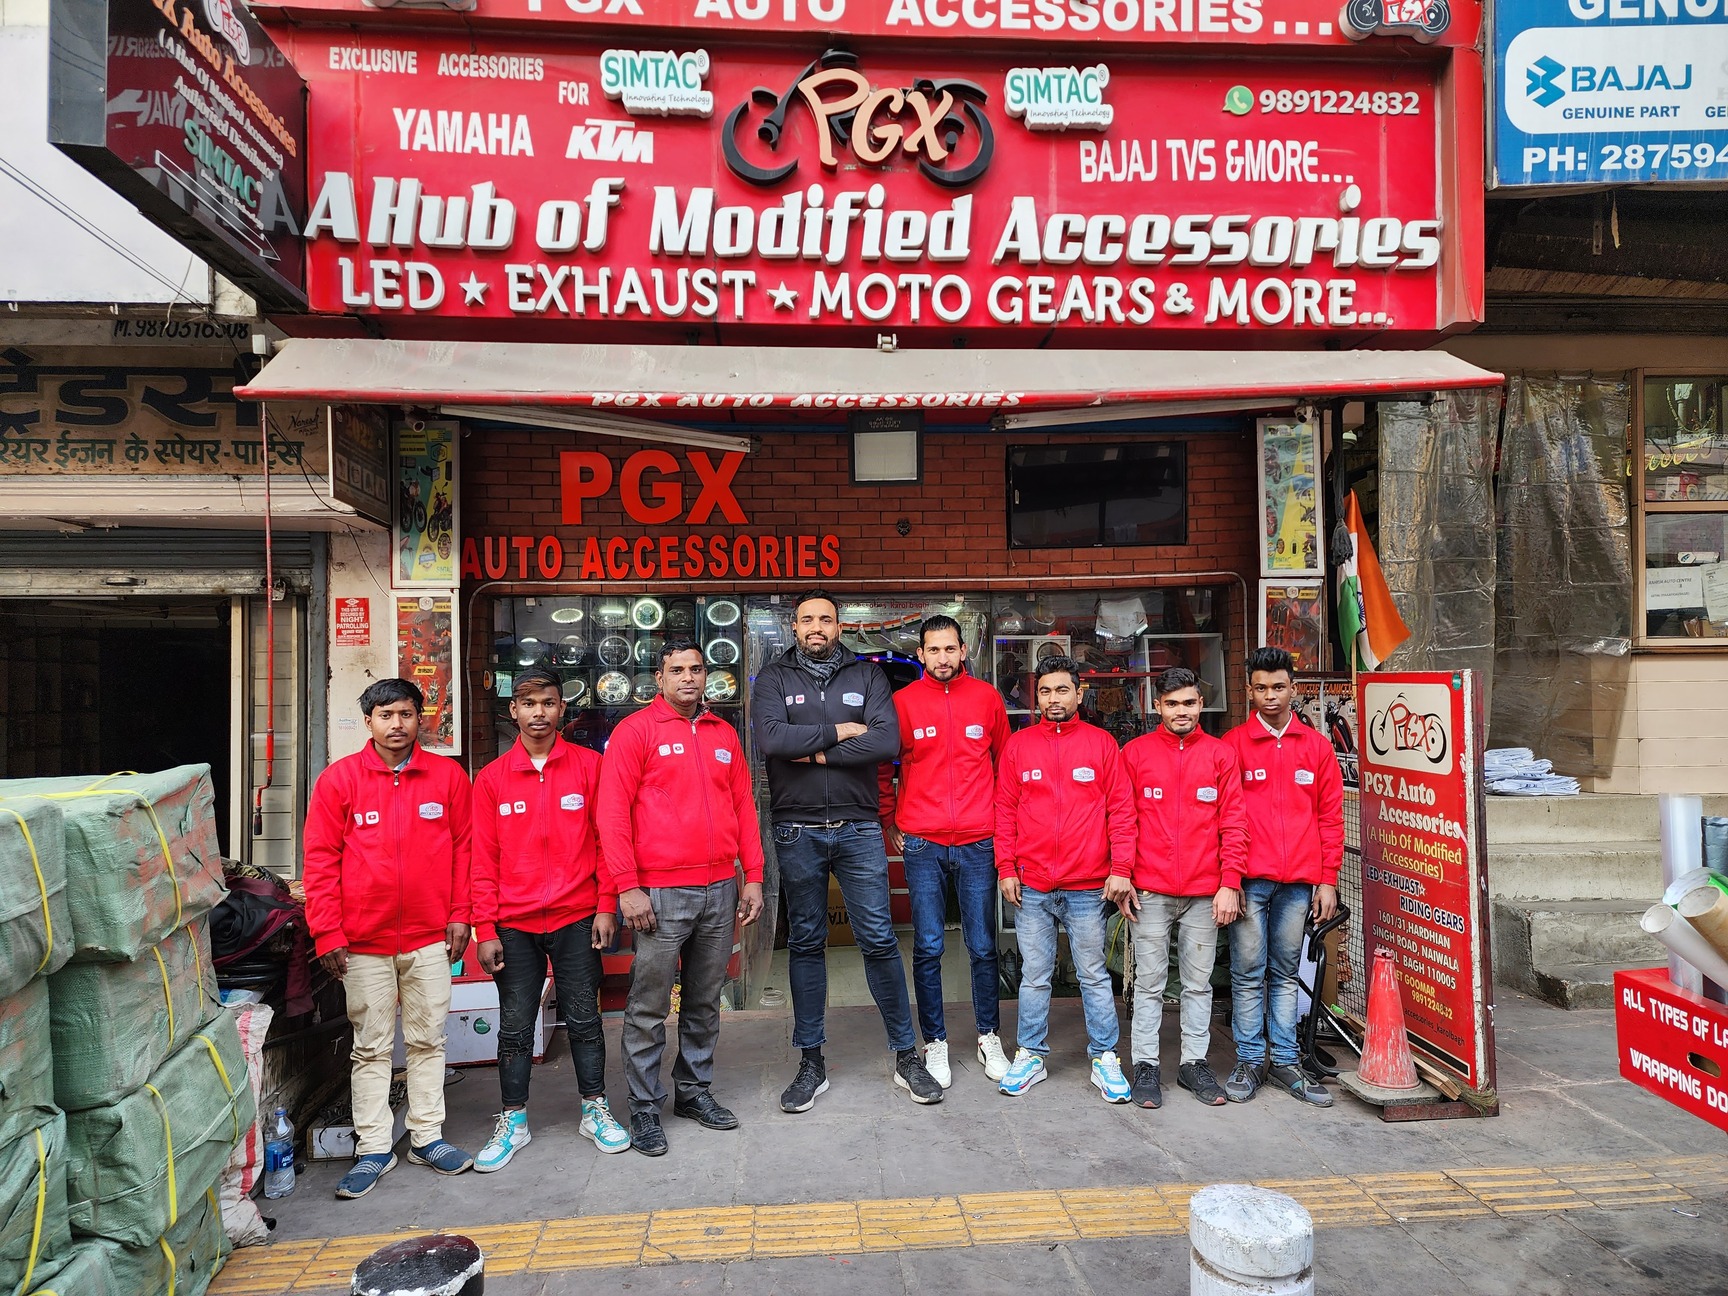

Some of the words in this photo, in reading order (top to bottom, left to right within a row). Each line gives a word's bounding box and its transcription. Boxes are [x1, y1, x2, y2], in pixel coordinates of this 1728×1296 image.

[179, 7, 222, 71] Auto
[223, 54, 297, 158] Accessories
[329, 46, 418, 75] EXCLUSIVE
[437, 52, 545, 82] ACCESSORIES
[558, 81, 589, 106] FOR
[1571, 63, 1692, 93] BAJAJ
[797, 67, 954, 173] PGX
[1259, 89, 1420, 116] 9891224832
[1562, 106, 1635, 120] GENUINE
[1640, 105, 1681, 118] PART
[1705, 106, 1728, 118] GE
[393, 108, 534, 158] YAMAHA
[565, 118, 654, 164] KTM
[1079, 139, 1158, 184] BAJAJ
[1166, 139, 1217, 183] TVS
[1523, 146, 1587, 173] PH:
[304, 171, 361, 243] A
[368, 176, 517, 252] Hub
[535, 177, 626, 253] of
[649, 183, 973, 267] Modified
[991, 183, 1442, 271] Accessories
[338, 257, 445, 311] LED
[505, 263, 756, 321] EXHAUST
[809, 270, 972, 323] MOTO
[987, 274, 1155, 325] GEARS
[1165, 283, 1195, 316] &
[591, 391, 662, 409] PGX
[675, 391, 775, 409] AUTO
[789, 390, 1025, 409] ACCESSORIES
[125, 431, 149, 462] के
[560, 449, 749, 526] PGX
[461, 534, 563, 580] AUTO
[580, 534, 842, 579] ACCESSORIES
[336, 622, 369, 630] PATROLLING
[1390, 703, 1434, 752] PGX
[1363, 771, 1395, 797] PGX
[1398, 777, 1436, 806] Auto
[1378, 800, 1461, 839] Accessories
[1379, 826, 1398, 847] Hub
[1399, 832, 1411, 850] Of
[1413, 837, 1463, 866] Modified
[1382, 847, 1444, 880] Accessories)
[1400, 895, 1433, 920] RIDING
[1433, 907, 1465, 933] GEARS
[1372, 924, 1396, 944] SINGH
[1396, 930, 1421, 957] ROAD,
[1421, 944, 1459, 973] NAIWALA
[1403, 954, 1425, 977] BAGH
[1427, 965, 1456, 990] 110005
[1404, 972, 1436, 998] GOOMAR
[1411, 989, 1453, 1020] 9891224832
[1623, 987, 1646, 1013] ALL
[1649, 997, 1689, 1032] TYPES
[1693, 1015, 1710, 1041] OF
[1630, 1047, 1702, 1100] WRAPPING
[1707, 1086, 1728, 1114] DO
